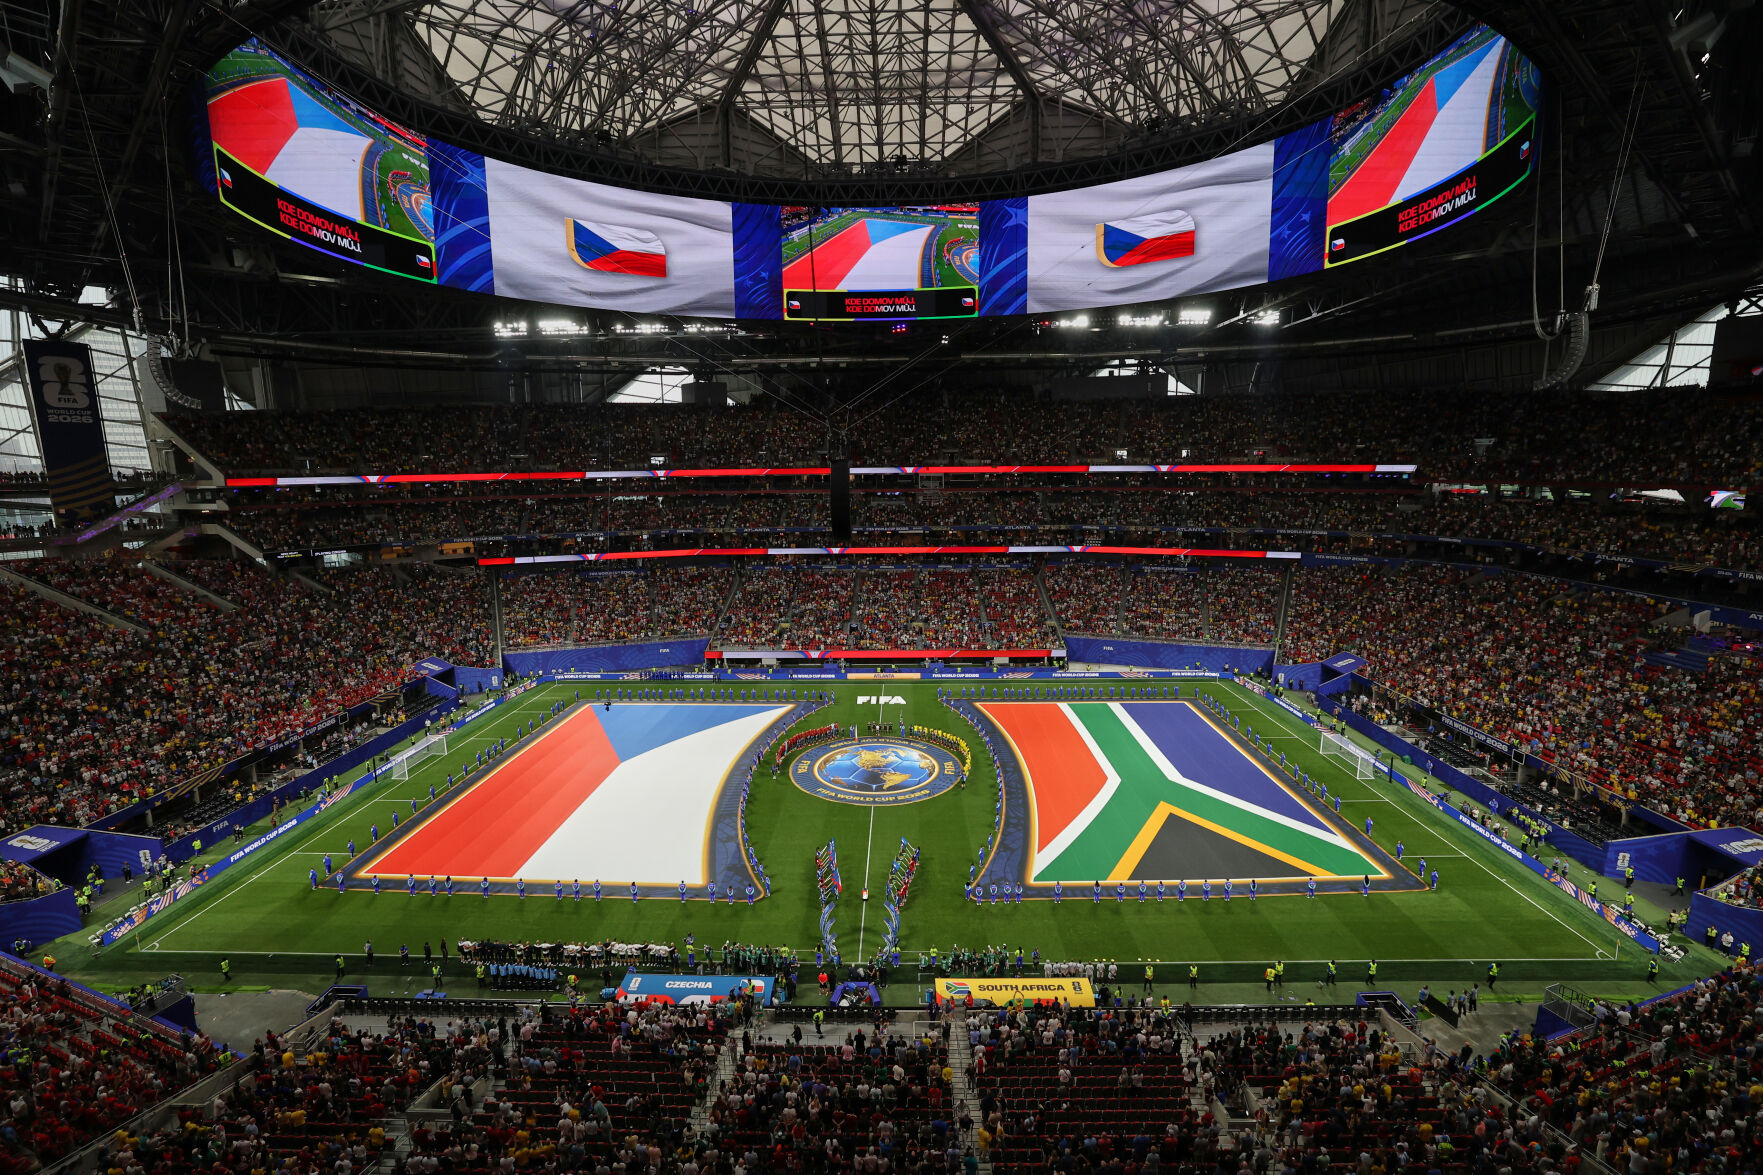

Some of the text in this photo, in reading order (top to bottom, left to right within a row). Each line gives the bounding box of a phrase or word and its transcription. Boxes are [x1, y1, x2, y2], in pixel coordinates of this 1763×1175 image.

[1398, 205, 1418, 223] KDE
[1418, 187, 1454, 214] DOMOV
[276, 198, 296, 217] KDE
[296, 208, 334, 232] DOMOV
[1398, 217, 1418, 234] KDE
[1418, 200, 1454, 225] DOMOV
[279, 211, 299, 230] KDE
[299, 221, 336, 244] DOMOV
[845, 298, 862, 306] KDE
[863, 297, 894, 305] DOMOV
[846, 305, 863, 313] KDE
[864, 304, 895, 313] DOMOV
[57, 396, 78, 404] FIFA
[47, 414, 94, 424] 2026
[1595, 554, 1634, 563] ATLANTA
[856, 695, 907, 705] FIFA
[269, 742, 284, 752] FIFA
[305, 727, 317, 736] CUP
[317, 718, 336, 731] 2026
[1441, 716, 1508, 752] FIFA WORLD CUP 2026
[797, 760, 811, 774] FIFA
[944, 761, 956, 775] FIFA
[816, 787, 836, 797] FIFA
[837, 793, 873, 801] WORLD
[897, 789, 931, 800] 2026
[212, 820, 229, 833] FIFA
[1537, 818, 1553, 833] FIFA
[230, 818, 298, 863] FIFA WORLD CUP 2026
[1459, 814, 1522, 859] FIFA WORLD CUP 2026
[665, 980, 712, 989] CZECHIA
[978, 984, 1065, 992] SOUTH AFRICA
